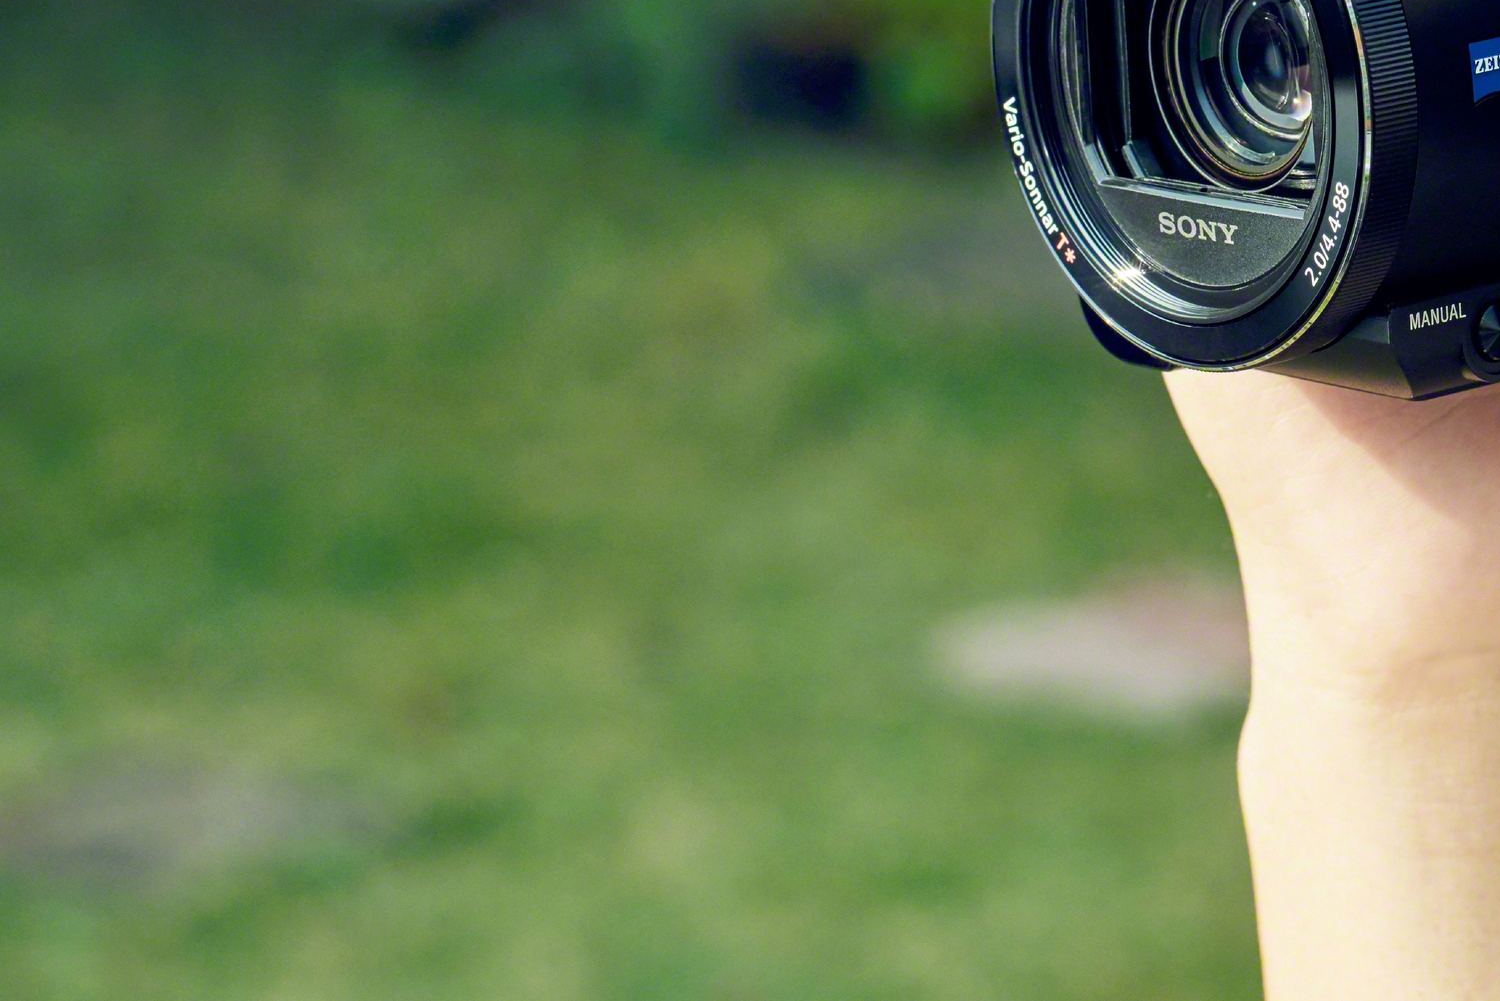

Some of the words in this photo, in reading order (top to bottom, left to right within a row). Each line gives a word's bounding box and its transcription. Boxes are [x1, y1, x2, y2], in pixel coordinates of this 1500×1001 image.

[1003, 96, 1058, 235] Vario-Sonnar
[1158, 211, 1239, 246] SONY
[1304, 181, 1350, 287] 2.0/4.4-88
[1409, 302, 1467, 331] MANUAL
